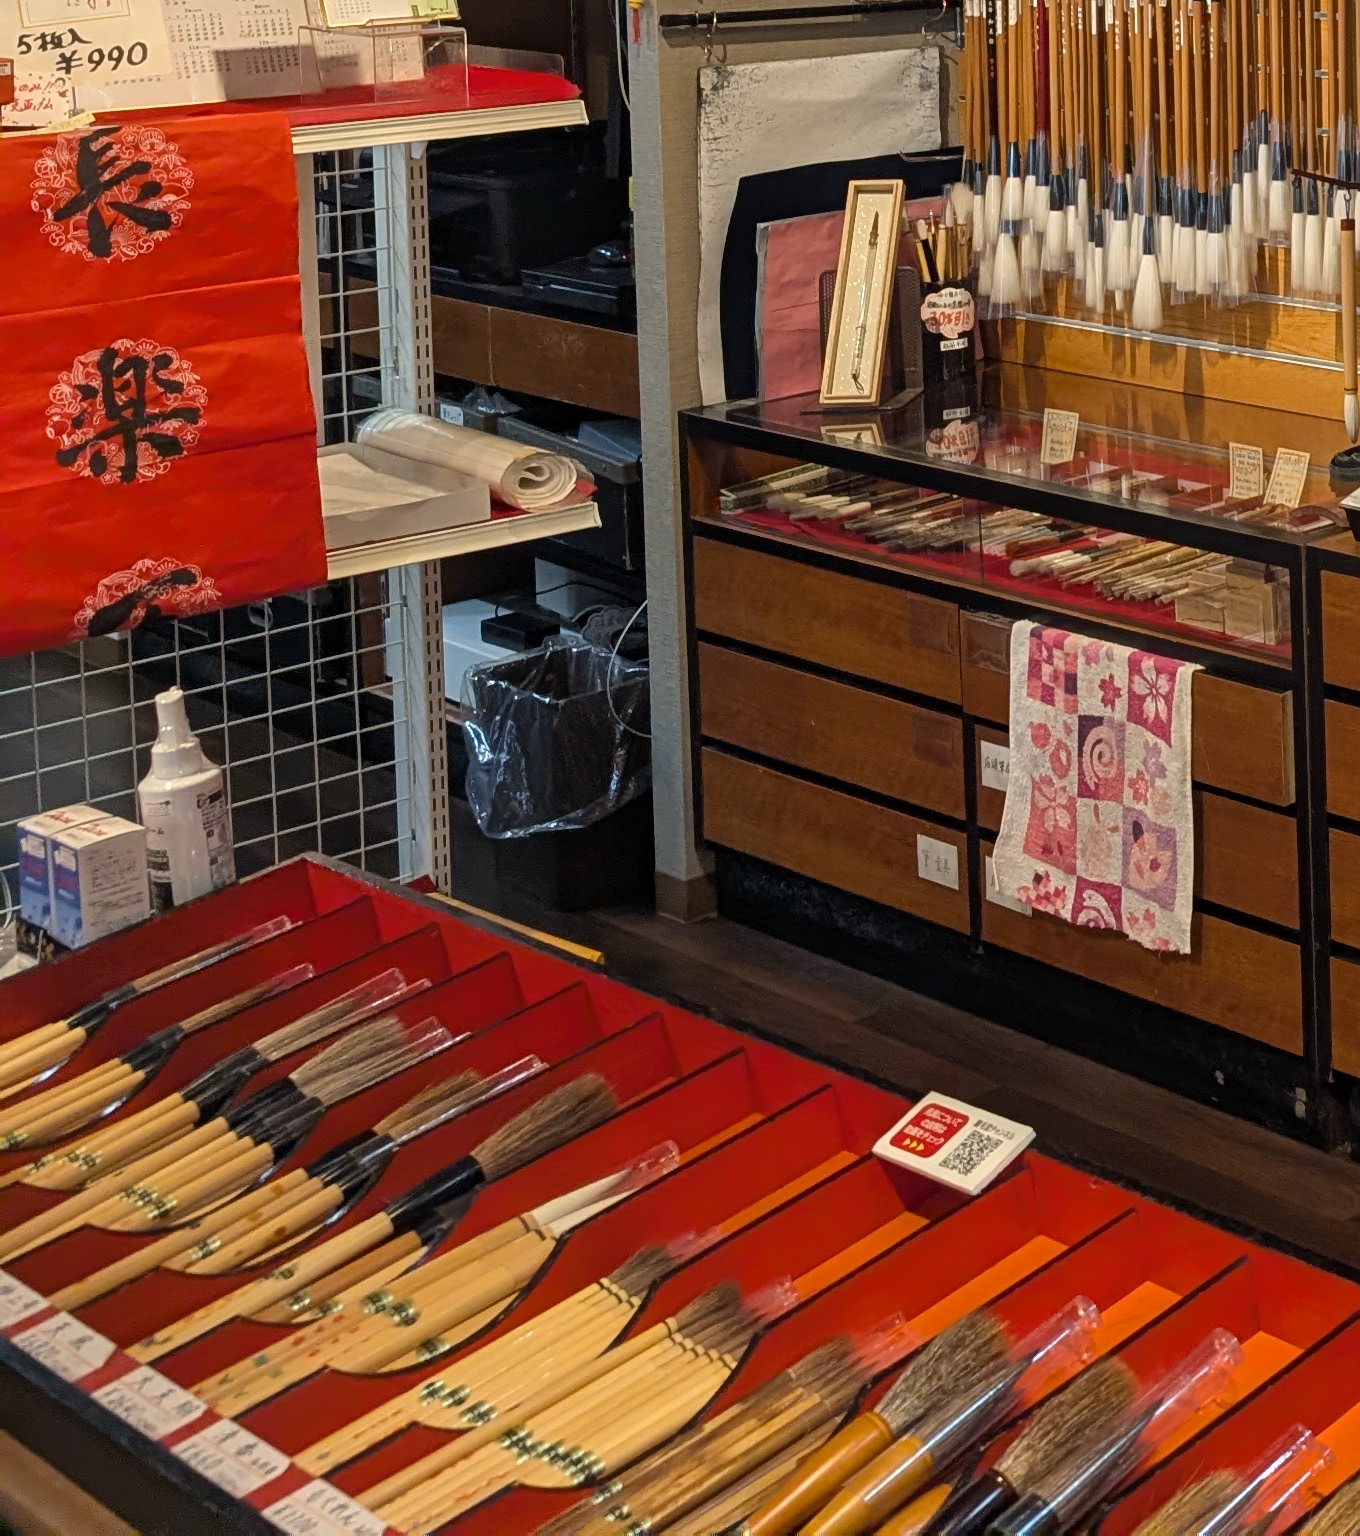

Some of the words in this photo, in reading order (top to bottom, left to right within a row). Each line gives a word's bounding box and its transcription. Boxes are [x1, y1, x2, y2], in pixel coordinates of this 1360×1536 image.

[17, 28, 93, 55] 5枚入
[55, 41, 148, 75] ¥990
[56, 347, 200, 483] 楽
